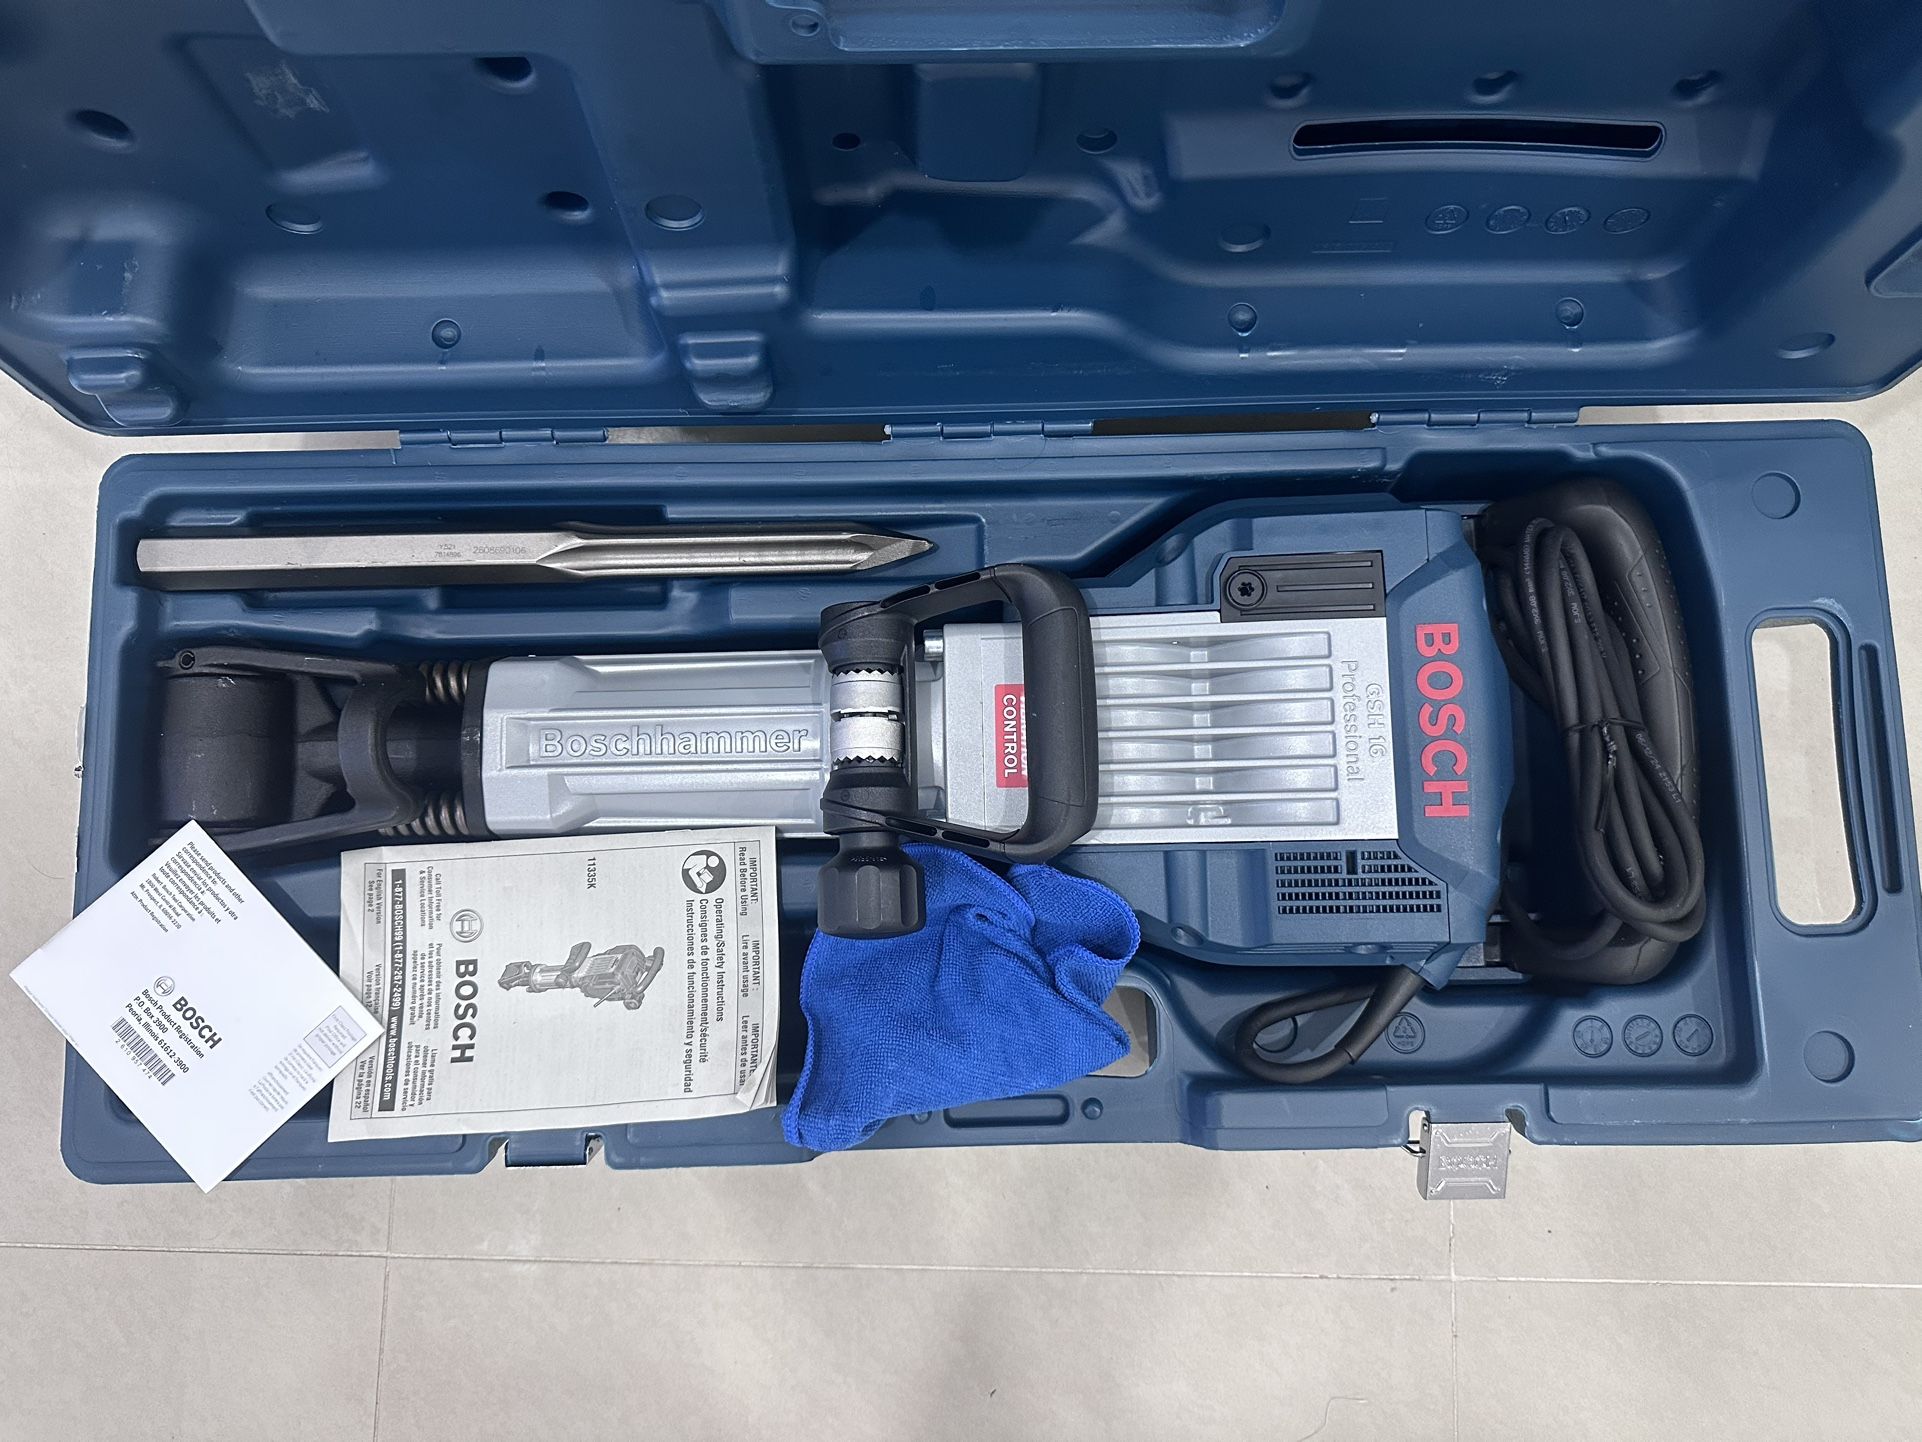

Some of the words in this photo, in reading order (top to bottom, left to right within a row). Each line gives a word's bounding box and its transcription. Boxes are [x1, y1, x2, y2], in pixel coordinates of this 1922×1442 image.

[1341, 660, 1365, 782] Professional
[1365, 682, 1386, 730] GSH
[1415, 623, 1470, 817] BOSCH
[539, 725, 808, 758] Boschhammer
[1002, 694, 1018, 778] CONTROL
[1367, 735, 1387, 758] 16
[168, 855, 203, 892] correspondencia
[180, 845, 213, 881] correspondence
[187, 840, 203, 856] Please
[199, 854, 212, 867] send
[207, 863, 228, 885] products
[224, 882, 235, 893] and
[232, 889, 246, 904] other
[434, 873, 442, 885] Call
[585, 856, 596, 889] 11335K
[749, 857, 758, 904] IMPORTANT:
[158, 865, 171, 879] toute
[167, 876, 200, 912] correspondance
[175, 850, 192, 868] Sirvase
[188, 865, 204, 881] enviar
[200, 878, 210, 888] los
[227, 908, 239, 920] otra
[177, 877, 195, 896] envoyer
[192, 892, 202, 901] les
[197, 899, 217, 920] produits
[391, 879, 406, 941] 1-877-BOSCH99
[698, 898, 709, 942] Consignes
[739, 894, 748, 916] Using
[686, 899, 696, 956] Instrucciones
[714, 897, 724, 968] Operating/Safety
[421, 952, 426, 960] de
[686, 958, 695, 969] de
[700, 944, 709, 955] de
[751, 939, 759, 985] IMPORTANT
[390, 942, 401, 1009] (1-877-267-2499)
[426, 960, 434, 986] adresses
[434, 958, 442, 978] obtenir
[372, 986, 380, 1014] française
[425, 987, 432, 995] de
[685, 971, 695, 1039] funcionamiento
[716, 971, 724, 1021] Instructions
[124, 1002, 145, 1024] Peoria,
[142, 1020, 161, 1041] Illinois
[132, 995, 146, 1009] P.O.
[142, 1006, 156, 1020] Box
[151, 1016, 169, 1034] 3900
[141, 987, 160, 1007] Bosch
[155, 1003, 178, 1027] Product
[172, 1023, 206, 1060] Registration
[171, 995, 222, 1050] BOSCH
[408, 1005, 416, 1025] gratuit
[432, 992, 440, 1029] informations
[450, 958, 479, 1063] BOSCH
[700, 957, 709, 1063] fonctionnement/sécurité
[740, 1015, 749, 1032] Leer
[382, 1015, 398, 1100] www.boschtools.com
[403, 1041, 413, 1077] ubicaciones
[420, 1045, 429, 1068] obtener
[739, 1057, 748, 1067] de
[740, 1034, 748, 1055] antes
[366, 1055, 375, 1078] Versión
[366, 1079, 371, 1087] en
[403, 1078, 410, 1086] de
[410, 1066, 419, 1101] consumidor
[426, 1068, 435, 1085] gratis
[682, 1048, 694, 1093] seguridad
[355, 1078, 364, 1099] página
[355, 1100, 362, 1108] 22
[362, 1088, 371, 1112] español
[400, 1087, 409, 1111] servicio
[417, 1069, 427, 1105] información
